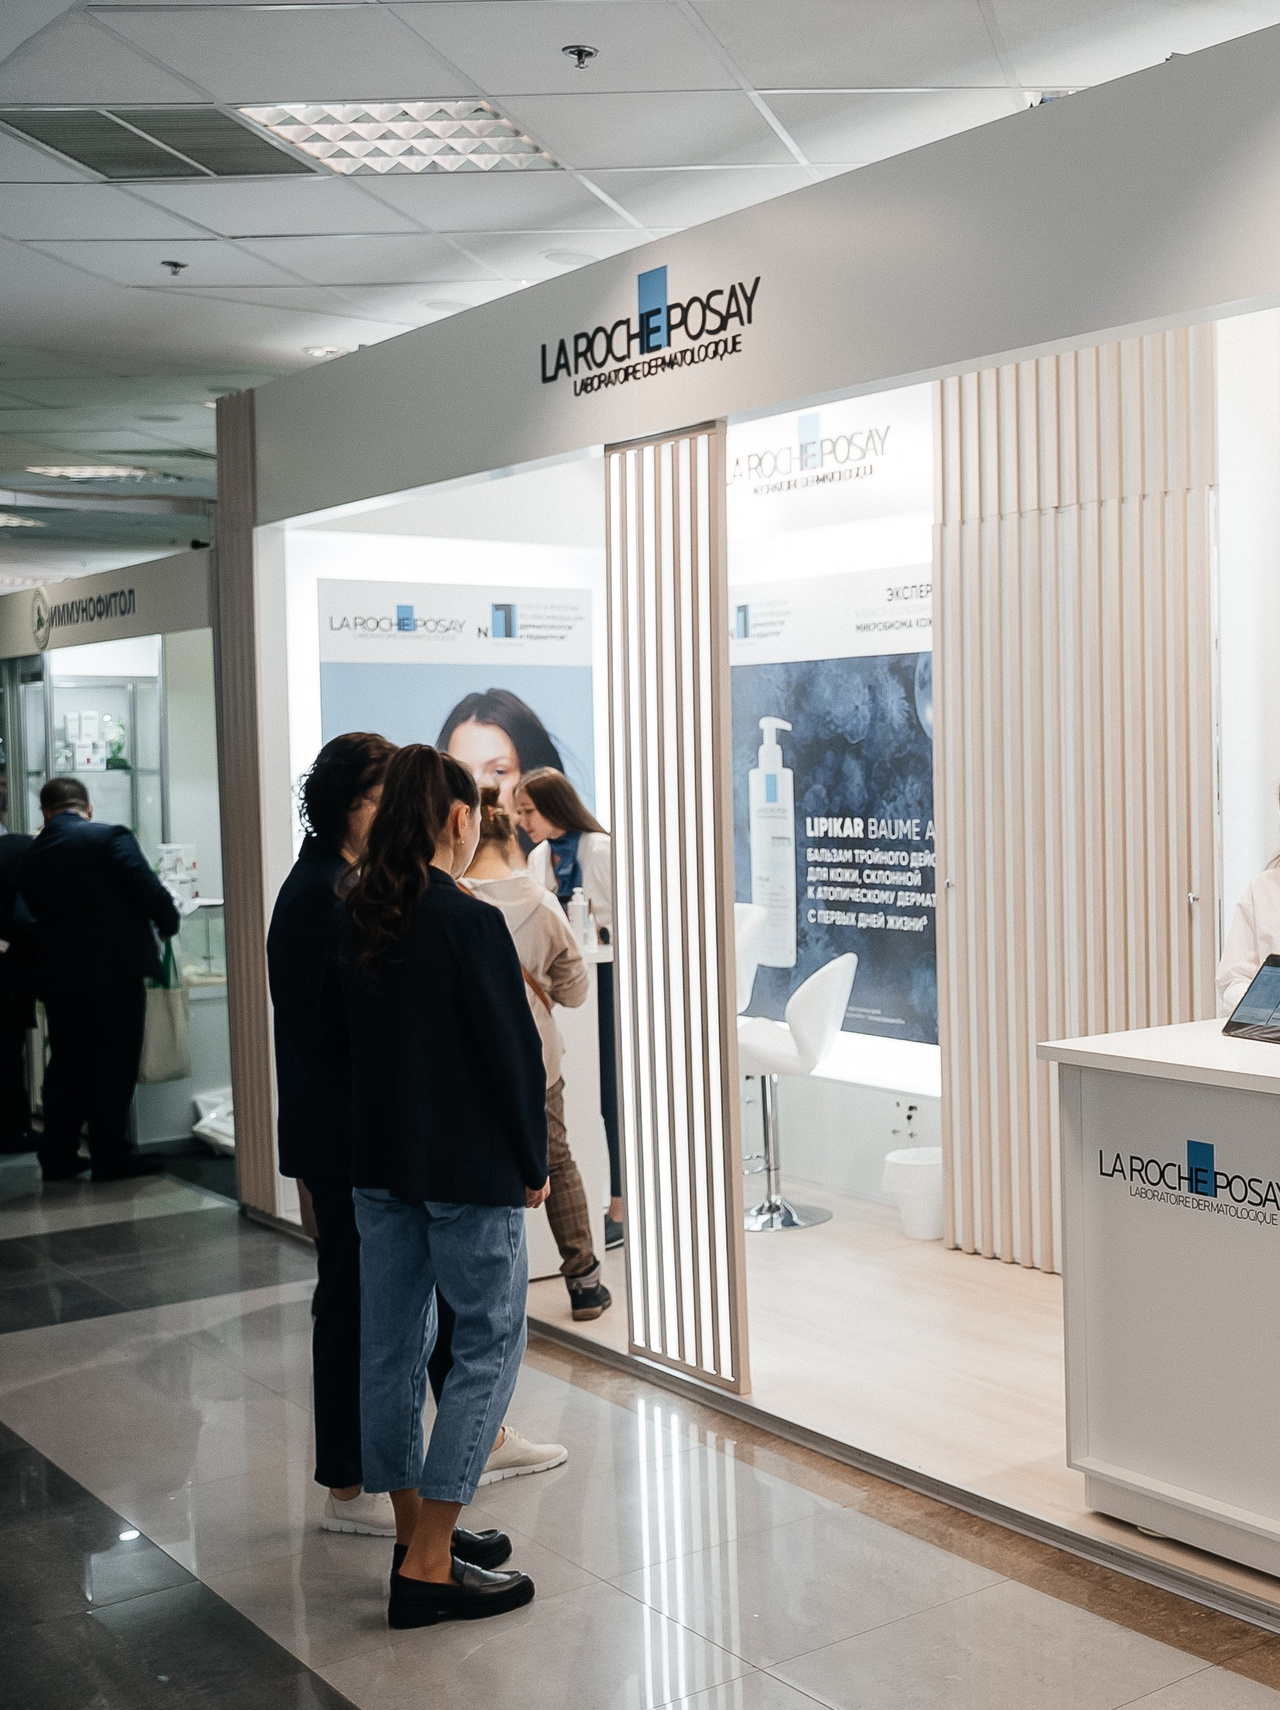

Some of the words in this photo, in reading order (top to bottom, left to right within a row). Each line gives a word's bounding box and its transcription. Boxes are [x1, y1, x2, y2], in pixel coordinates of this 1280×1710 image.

[541, 337, 572, 384] LA
[573, 307, 663, 375] ROCHE
[666, 276, 761, 348] POSAY
[573, 362, 642, 397] LABORATOIRE
[642, 333, 742, 378] DERMATOLOGIQUE
[747, 441, 818, 480] ROCHE
[820, 425, 891, 467] POSAY
[49, 588, 136, 628] ИММУНОФИТОЛ
[330, 616, 351, 631] LA
[354, 616, 411, 632] ROCHE
[415, 618, 466, 634] POSAY
[805, 817, 865, 838] LIPIKAR
[867, 818, 921, 841] BAUME
[806, 847, 853, 862] БАЛЬЗАМ
[853, 847, 909, 866] ТРОЙНОГО
[807, 866, 828, 882] ДЛЯ
[829, 868, 862, 885] КОЖИ,
[862, 869, 922, 886] СКЛОННОЙ
[807, 886, 815, 900] К
[816, 886, 896, 905] АТОПИЧЕСКОМУ
[807, 908, 817, 923] С
[817, 909, 857, 926] ПЕРВЫХ
[857, 911, 886, 929] ДНЕЙ
[1099, 1149, 1127, 1181] LA
[1129, 1155, 1209, 1196] ROCHE
[1129, 1185, 1191, 1208] LABORATOIRE
[1191, 1198, 1279, 1226] DERMATOLOGIQUE
